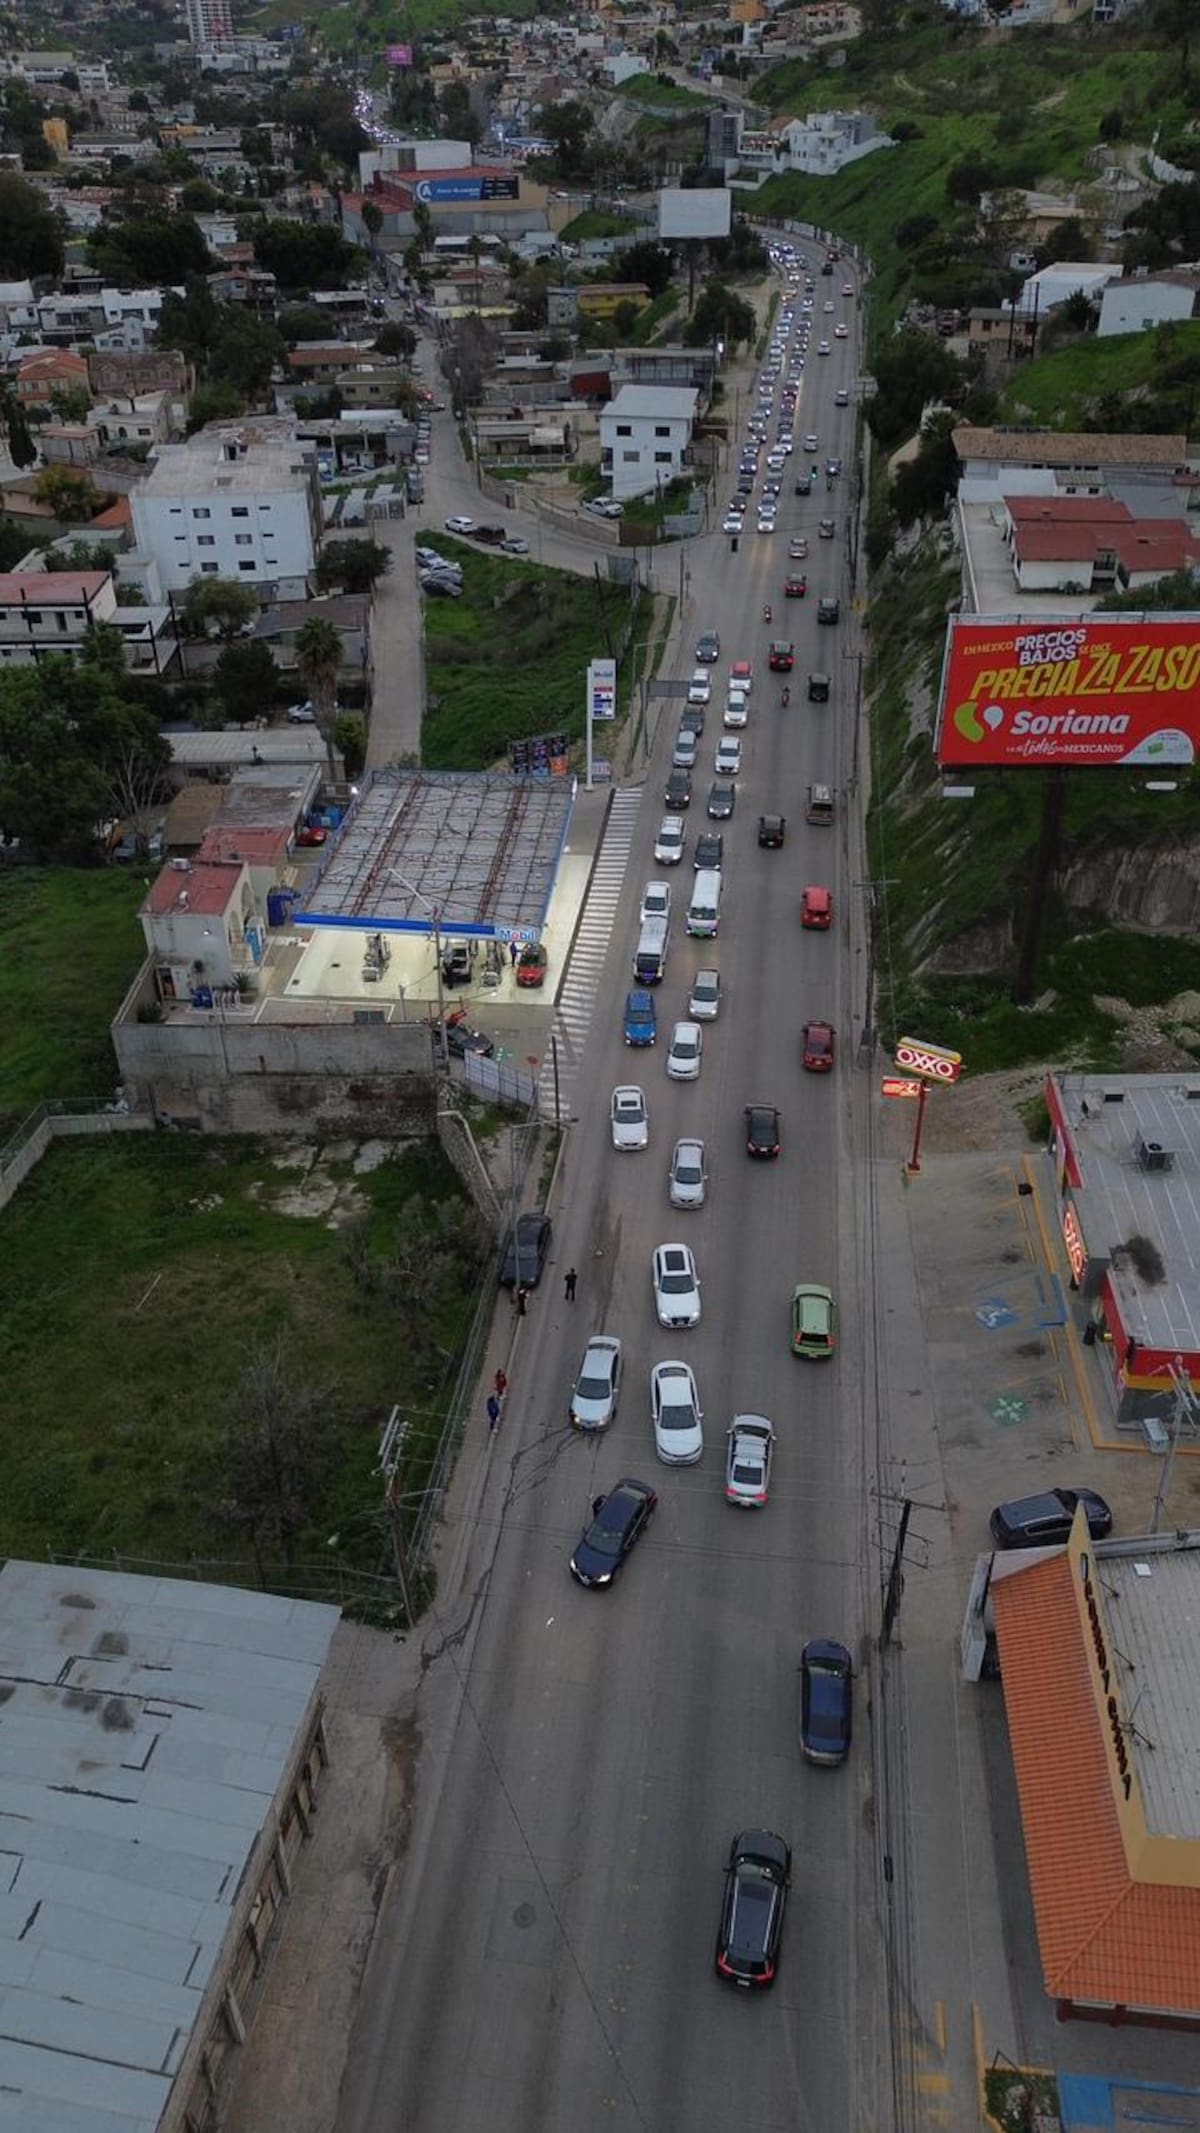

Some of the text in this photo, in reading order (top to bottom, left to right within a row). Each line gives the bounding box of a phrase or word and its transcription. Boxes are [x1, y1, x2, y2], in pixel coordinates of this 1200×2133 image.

[976, 640, 1014, 654] MEXICO
[1014, 629, 1087, 652] PRECIOS
[1019, 645, 1077, 666] BAJOS
[1010, 709, 1130, 735] Soriana
[500, 928, 535, 941] Mobil
[897, 1048, 953, 1077] OXXO
